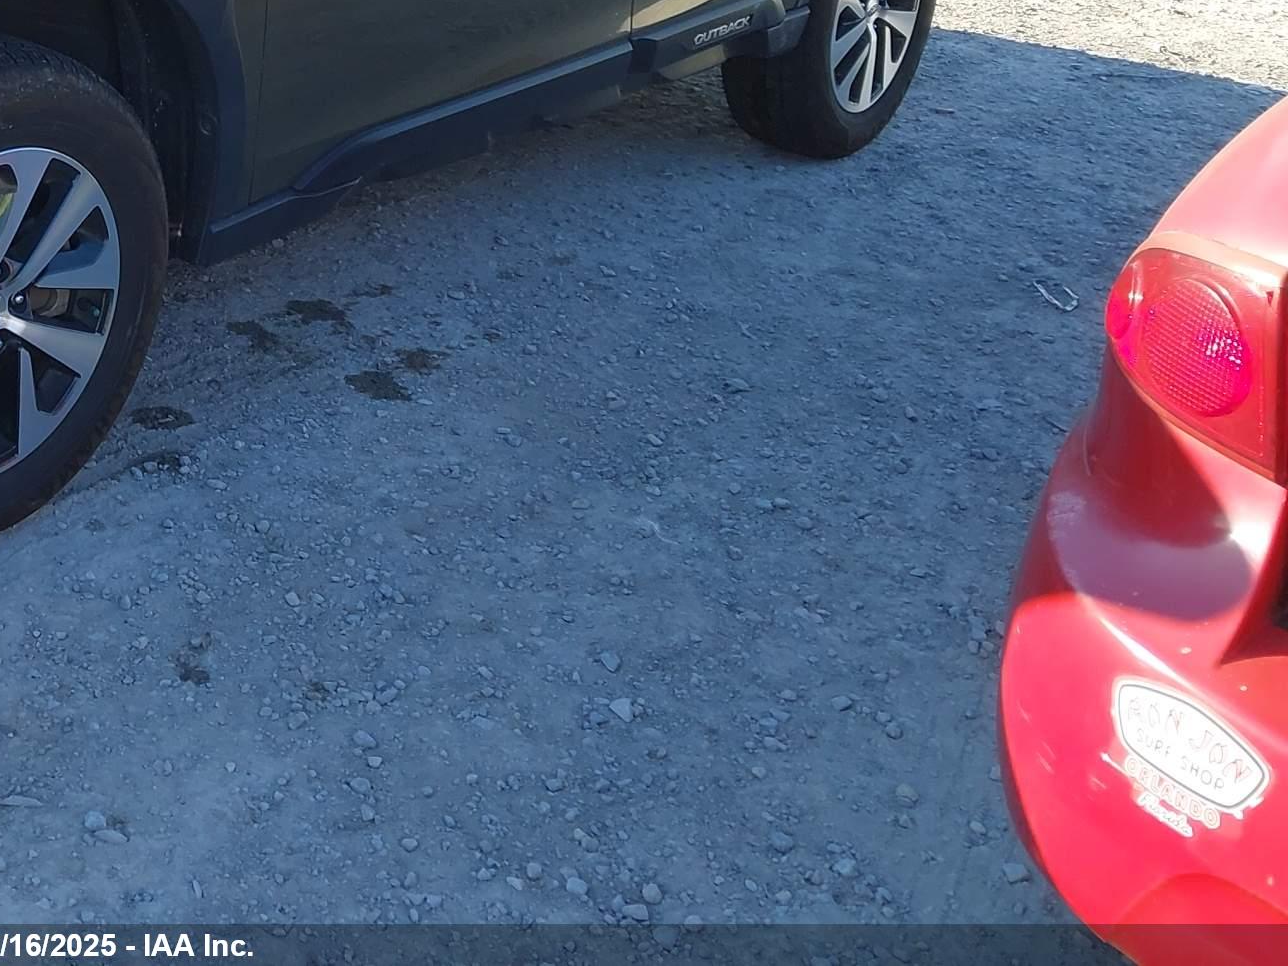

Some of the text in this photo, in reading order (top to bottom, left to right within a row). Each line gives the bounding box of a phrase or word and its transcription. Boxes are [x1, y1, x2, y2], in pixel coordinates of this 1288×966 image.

[693, 15, 751, 46] OUTBACK
[1136, 727, 1225, 791] SURF SHOP
[1188, 729, 1253, 785] JON
[1125, 757, 1220, 828] ORLANDO
